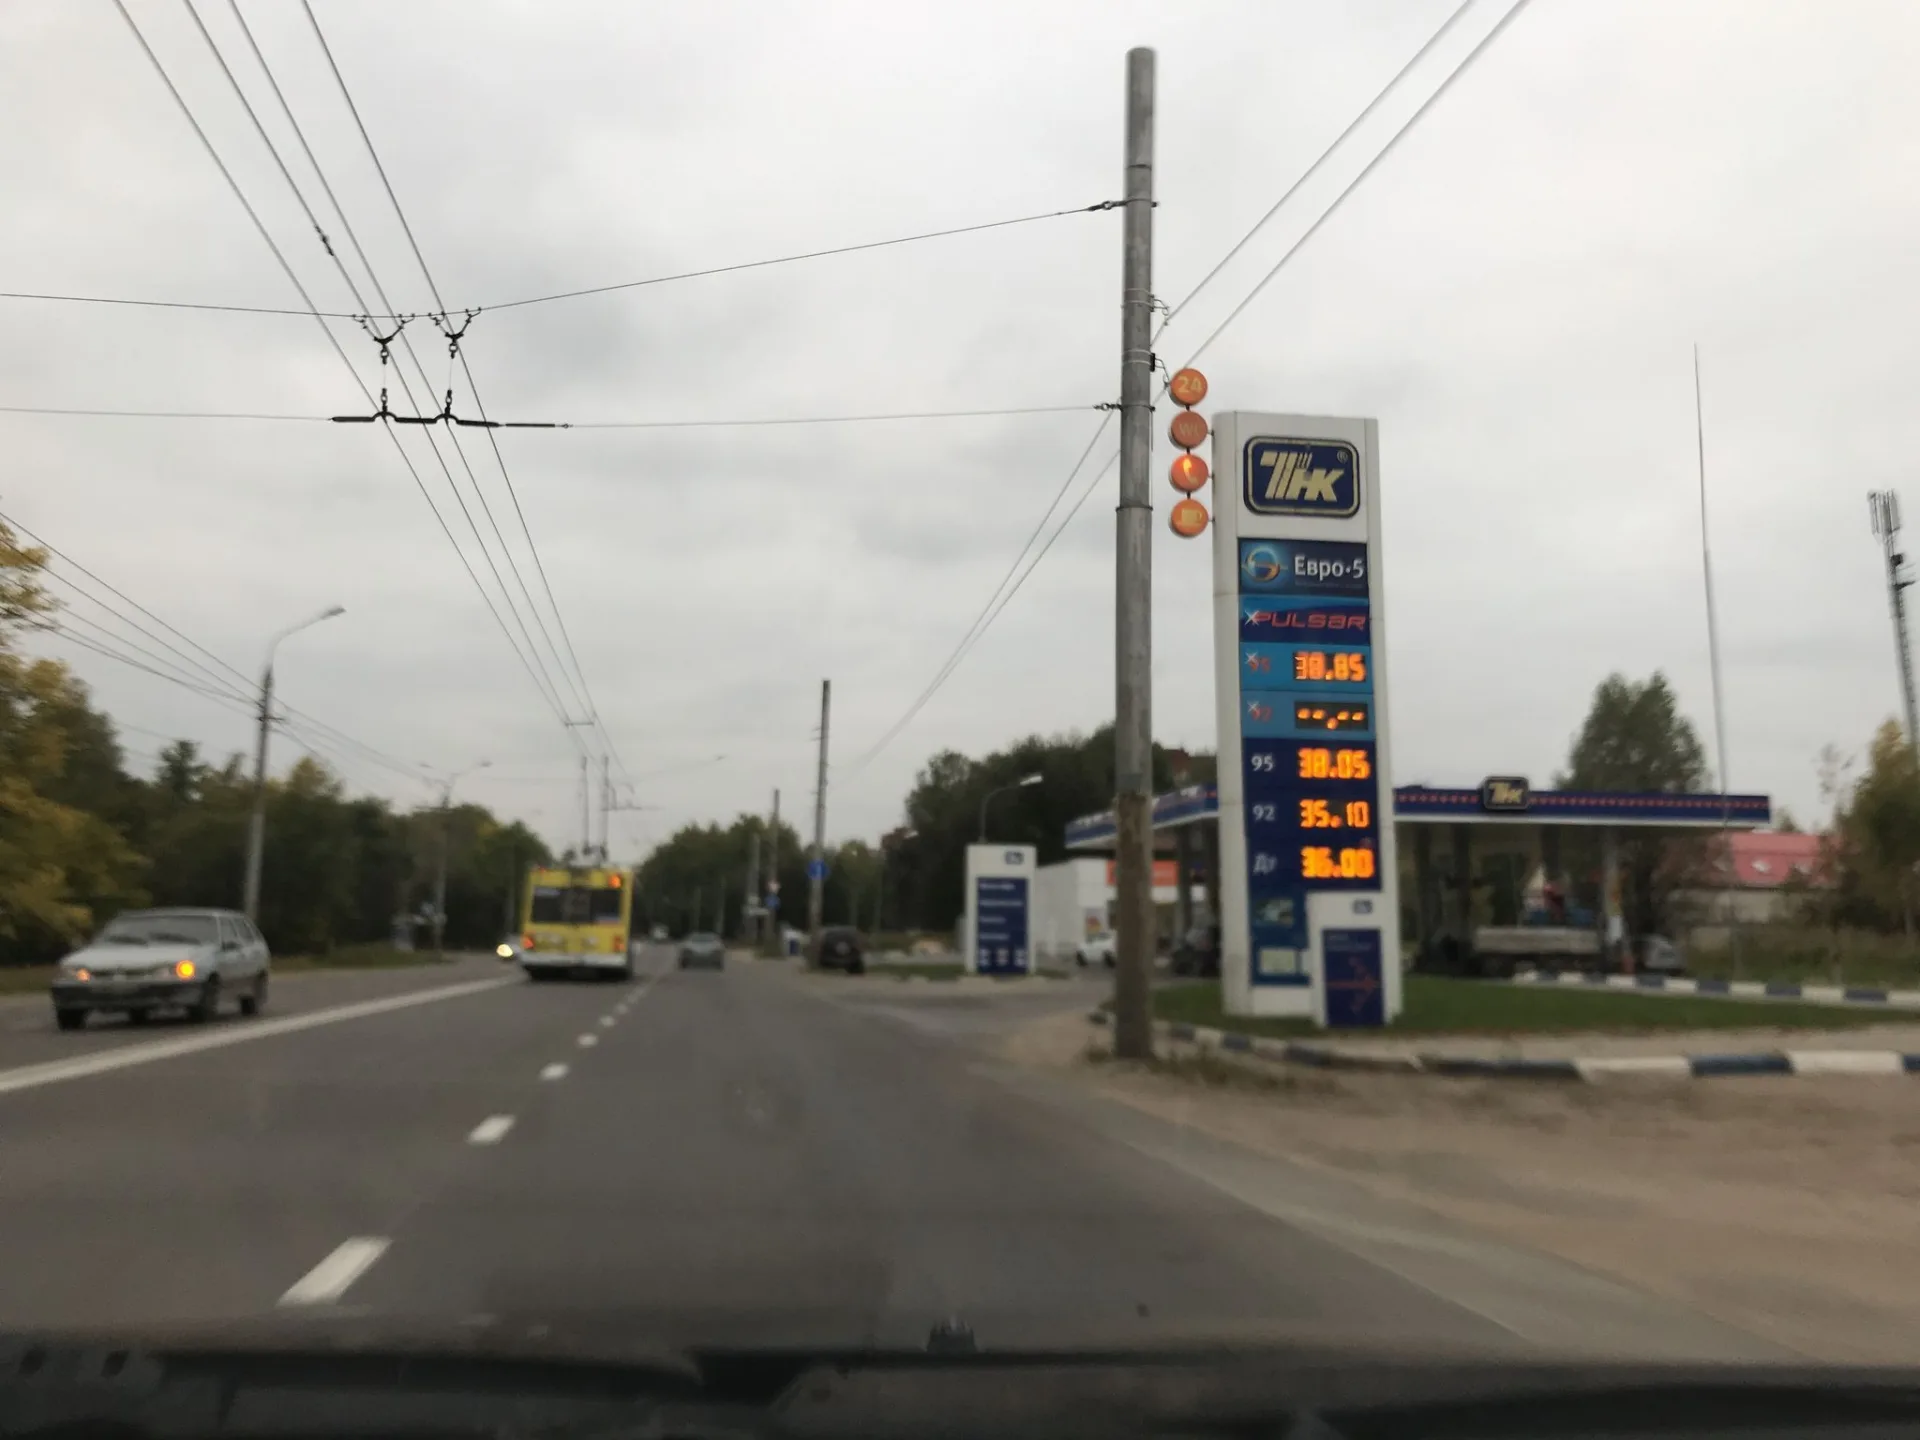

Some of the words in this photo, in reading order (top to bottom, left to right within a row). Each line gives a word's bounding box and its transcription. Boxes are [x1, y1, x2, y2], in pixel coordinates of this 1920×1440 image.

[1177, 375, 1202, 394] 24
[1251, 754, 1274, 772] 95
[1253, 805, 1275, 821] 92
[1300, 799, 1370, 828] 35.10
